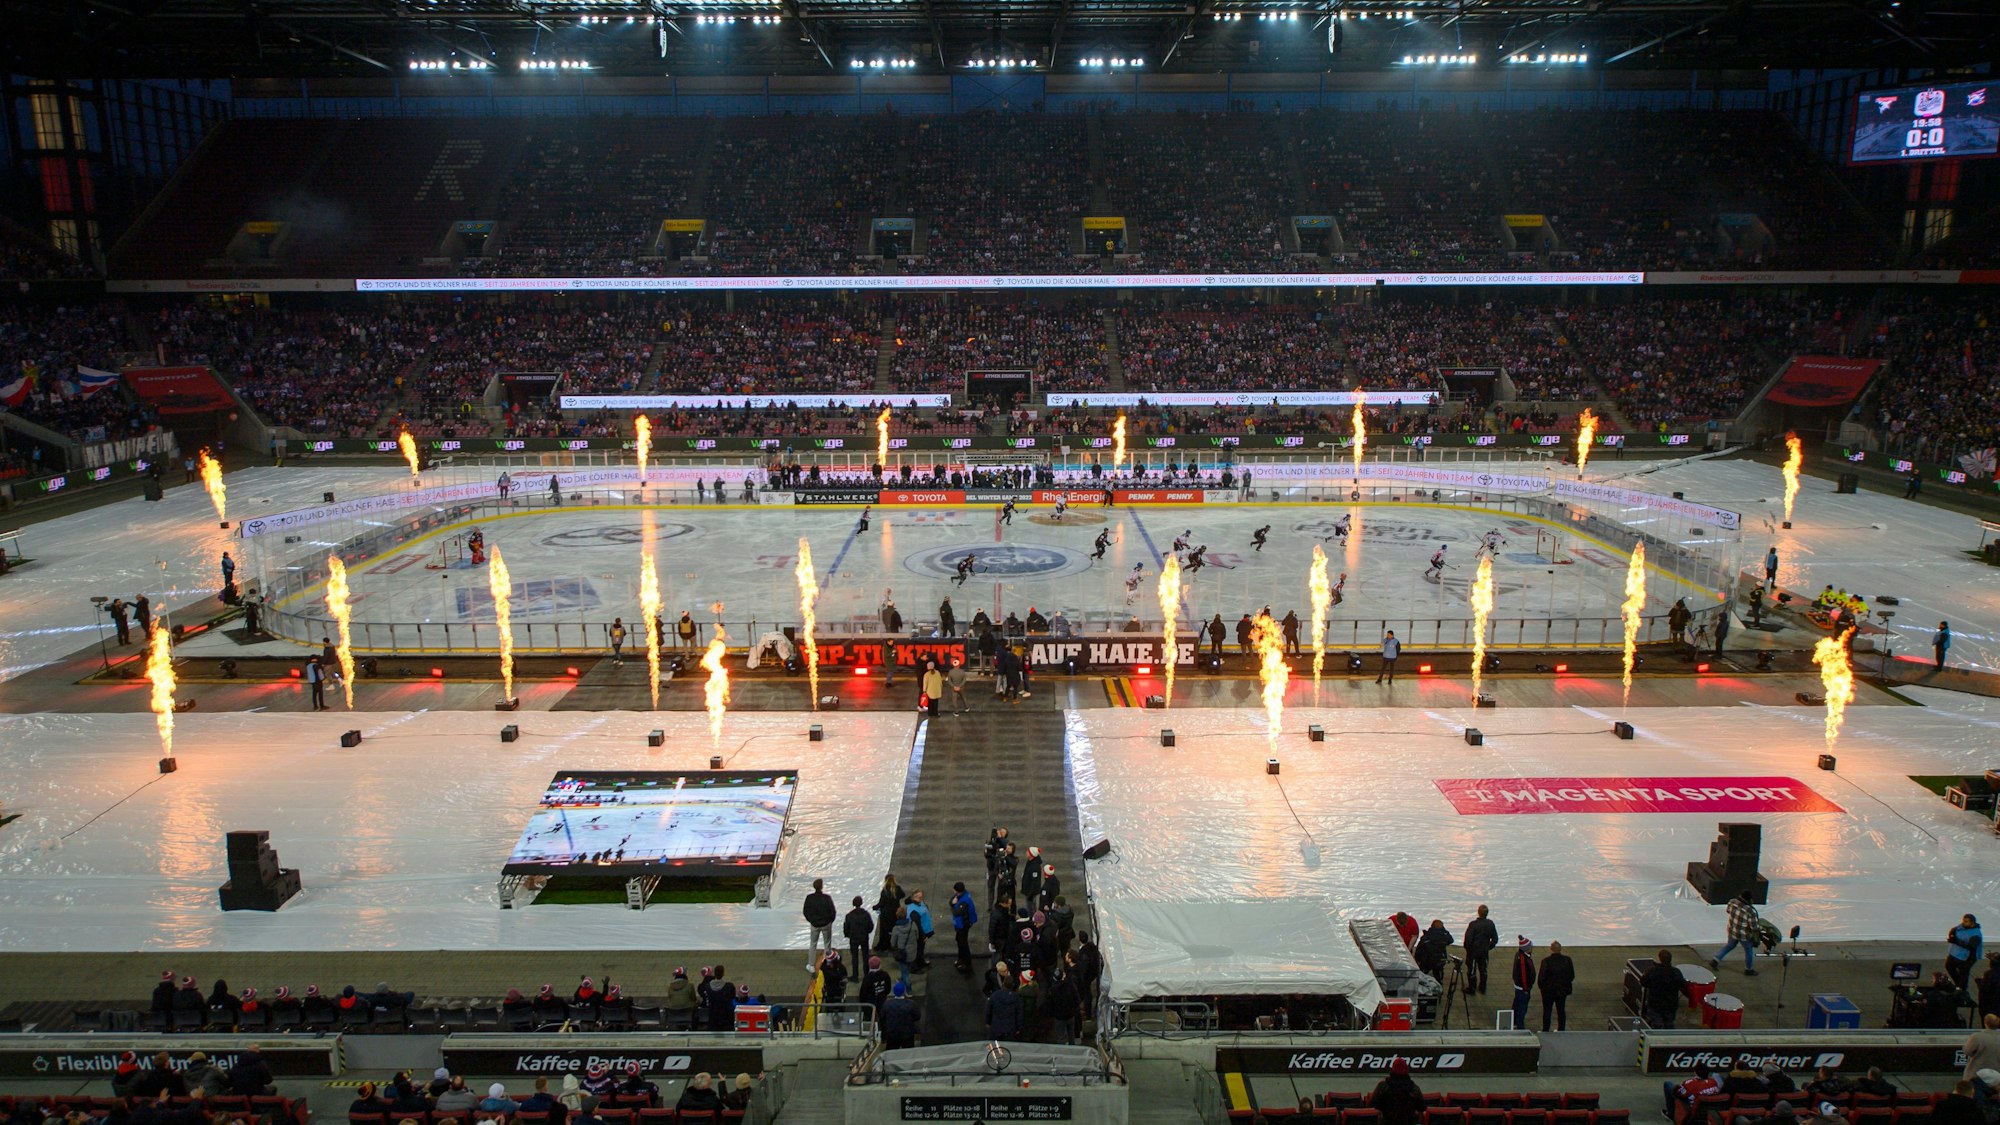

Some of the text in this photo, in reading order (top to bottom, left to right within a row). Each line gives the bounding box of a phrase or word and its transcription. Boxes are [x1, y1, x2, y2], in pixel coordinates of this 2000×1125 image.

[1912, 118, 1942, 128] 19:58
[1906, 128, 1944, 147] 0:0
[414, 140, 485, 200] R
[1496, 478, 1529, 486] TOYOTA
[800, 644, 966, 666] VIP-TIKETS
[1032, 644, 1082, 664] AUF
[1500, 788, 1680, 804] MAGENTA
[1681, 787, 1798, 802] SPORT
[56, 1056, 122, 1070] Flexibl
[516, 1055, 581, 1070] Kaffee
[1288, 1053, 1354, 1069] Kaffee
[1666, 1052, 1732, 1068] Kaffee
